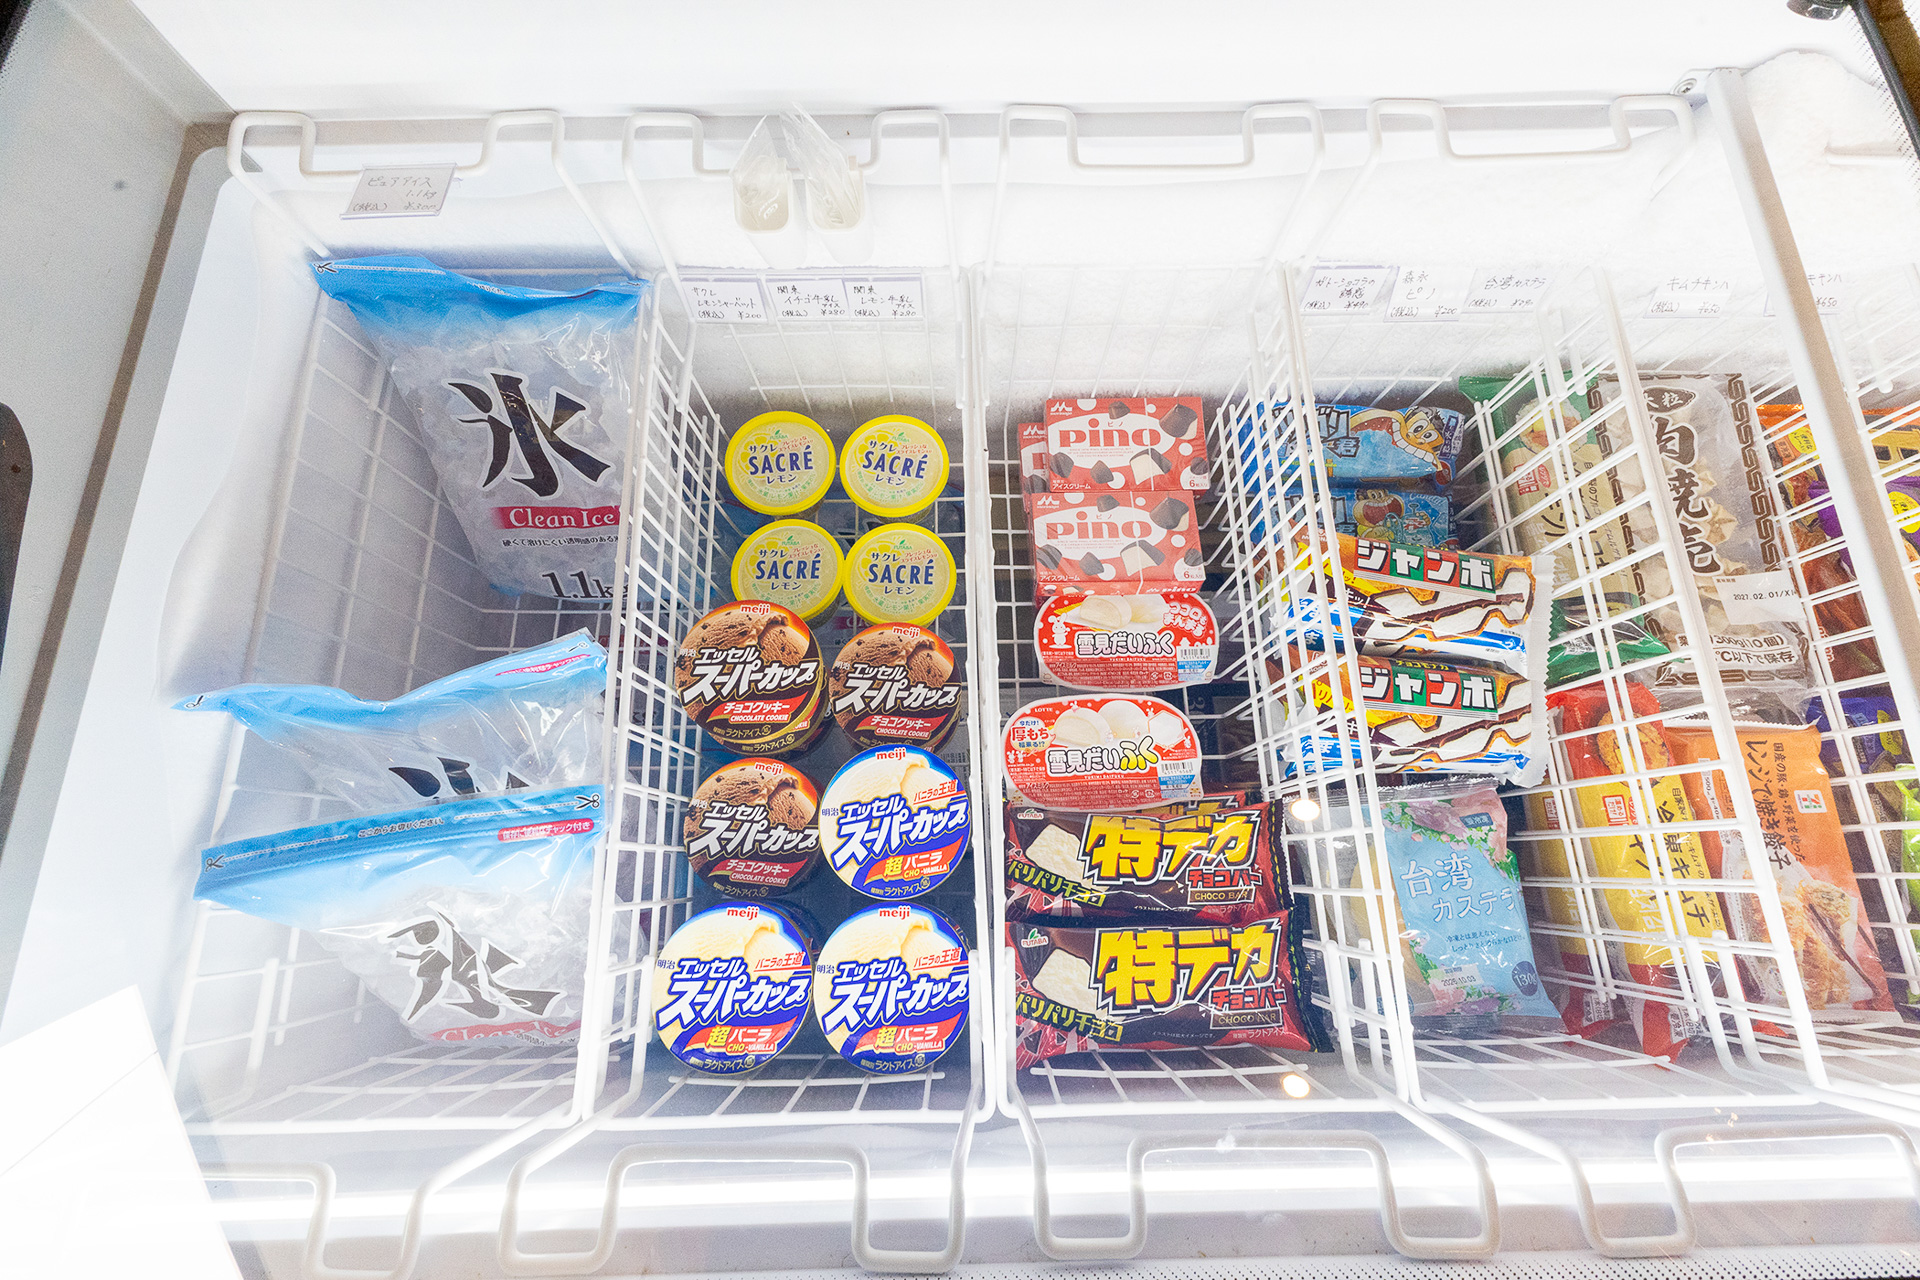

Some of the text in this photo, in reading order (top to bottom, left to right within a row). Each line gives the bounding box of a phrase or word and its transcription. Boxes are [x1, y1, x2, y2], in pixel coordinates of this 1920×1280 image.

[368, 176, 432, 188] ピュアアイス
[448, 373, 611, 497] 氷
[1059, 418, 1161, 448] pino
[749, 444, 777, 453] サクレ
[869, 440, 896, 452] サクレ
[749, 445, 813, 475] SACRÉ
[863, 450, 928, 479] SACRÉ
[767, 474, 797, 484] レモン
[876, 474, 905, 485] レモン
[509, 508, 616, 528] Clean Ice
[1046, 511, 1152, 540] pino
[759, 550, 788, 558] サクレ
[872, 552, 900, 562] サクレ
[756, 553, 821, 580] SACRÉ
[868, 559, 934, 584] SACRÉ
[1357, 538, 1494, 593] ジャンボ
[771, 582, 801, 590] レモン
[885, 586, 915, 594] レモン
[741, 603, 770, 615] meiji
[893, 626, 920, 638] meiji
[1076, 631, 1174, 656] 雪見だいふく
[696, 647, 758, 664] エッセル
[849, 664, 907, 680] エッセル
[684, 659, 816, 703] スーパーカップ
[1360, 666, 1495, 711] ジャンボ
[836, 680, 958, 712] スーパーカップ
[724, 702, 790, 714] チョコクッキー
[730, 714, 788, 722] CHOCOLATE COOKIE
[871, 716, 931, 729] チョコクッキー
[726, 728, 762, 738] ラクトアイス
[876, 727, 930, 738] CHOCOLATE COOKIE
[1012, 728, 1049, 741] 厚もち
[754, 740, 786, 752] ラクトアイス
[876, 748, 906, 762] meiji
[1048, 736, 1158, 774] 雪見だいふく
[755, 762, 783, 775] meiji
[914, 779, 958, 801] バニラの王道
[704, 802, 767, 820] エッセル
[822, 795, 903, 824] 明治 エッセル
[1745, 740, 1792, 870] レンジで焼き餃子
[690, 818, 818, 857] スーパーカップ
[833, 802, 969, 868] スーパーカップ
[1086, 815, 1254, 878] 特デカ
[726, 860, 790, 876] チョコクッキー
[1401, 853, 1472, 898] 台湾
[731, 873, 788, 884] CHOCOLATE COOKIE
[1008, 861, 1106, 907] パリパリチョコ
[1188, 870, 1261, 887] チョコバー
[725, 886, 759, 896] ラクトアイス
[884, 884, 921, 896] ラクトアイス
[1195, 892, 1226, 900] CHOCO
[727, 907, 759, 918] meiji
[879, 907, 911, 919] meiji
[1433, 888, 1515, 922] カステラ
[1022, 938, 1047, 947] FUTABA
[387, 901, 561, 1021] 氷
[755, 952, 802, 970] バニラの王道
[914, 948, 960, 970] バニラの王道
[1097, 925, 1276, 1006] 特デカ
[657, 958, 744, 979] 明治 エッセル
[817, 960, 906, 982] 明治 エッセル
[658, 977, 811, 1026] スーパーカップ
[824, 974, 968, 1030] スーパーカップ
[1212, 988, 1285, 1010] チョコバー
[1016, 994, 1123, 1041] パリパリチョコ
[1218, 1015, 1254, 1025] CHOCO
[1249, 1028, 1285, 1039] ラクトアイス
[704, 1059, 744, 1071] ラクトアイス
[875, 1059, 915, 1071] ラクトアイス
